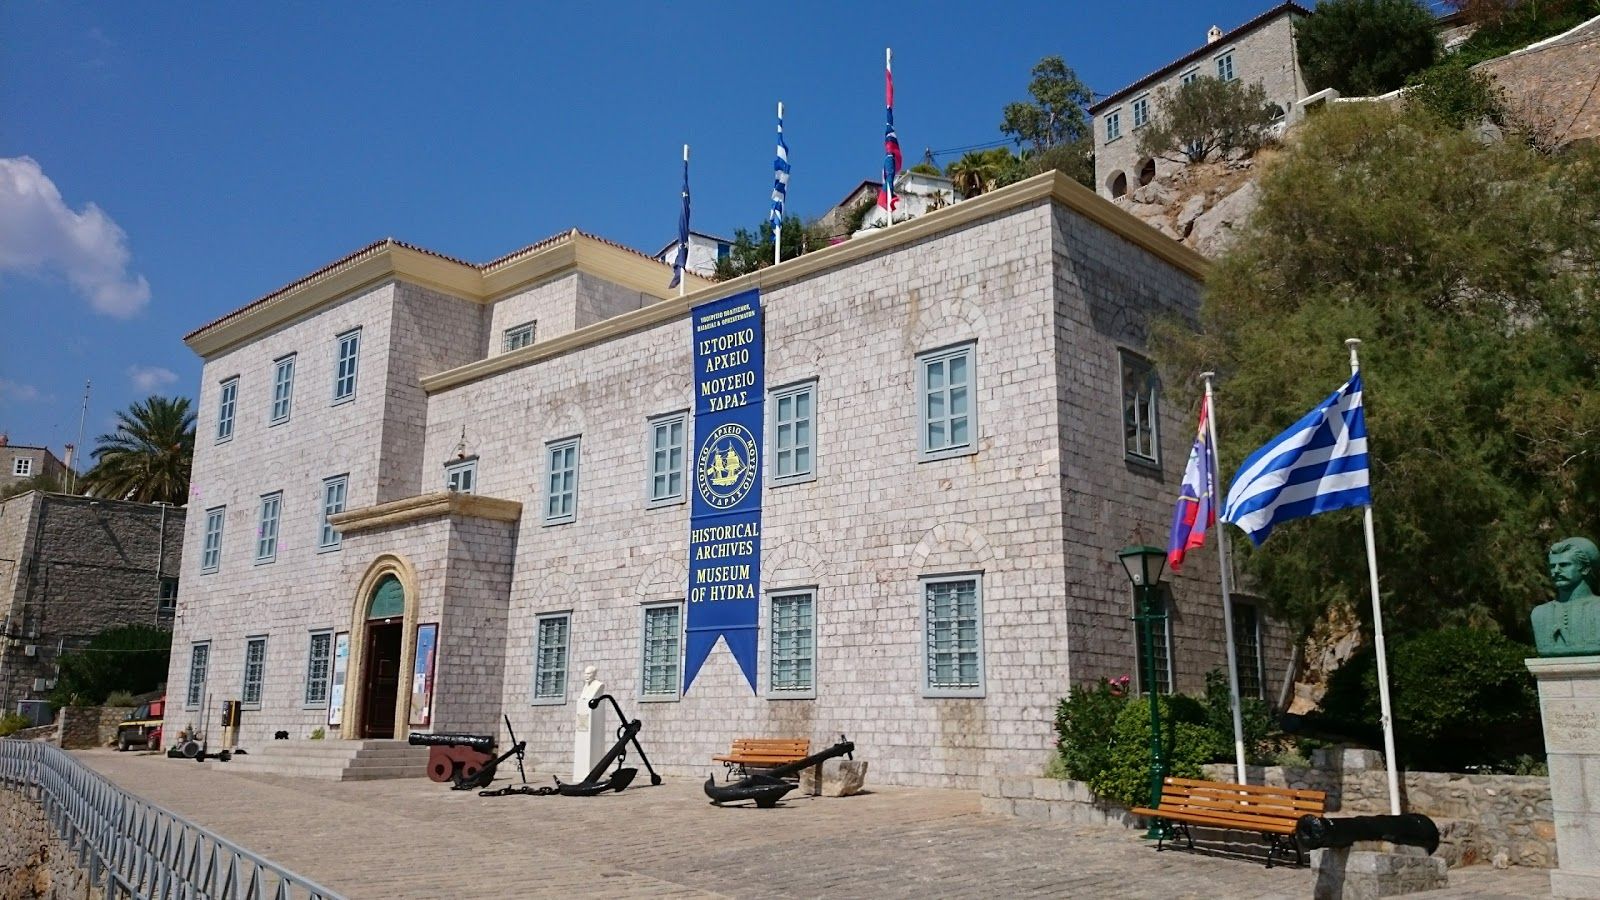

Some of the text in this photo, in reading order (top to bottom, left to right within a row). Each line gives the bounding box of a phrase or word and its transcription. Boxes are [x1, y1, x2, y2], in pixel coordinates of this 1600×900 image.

[700, 328, 754, 356] ΙΣΤΟΡΙΚΟ
[706, 349, 749, 373] ΑΡΧΕΙΟ
[701, 371, 755, 396] ΜΟΥΣΕΙΟ
[709, 391, 747, 412] ΥΔΡΑΣ
[713, 426, 741, 440] ΑΡΧΕΙΟ
[743, 440, 756, 490] ΜΟΥΣΕΙΟ
[711, 491, 742, 506] ΥΔΡΑΣ
[691, 522, 759, 544] HISTORICAL
[696, 541, 753, 560] ARCHIVES
[697, 564, 750, 584] MUSEUM
[691, 583, 755, 603] OF HYDRA
